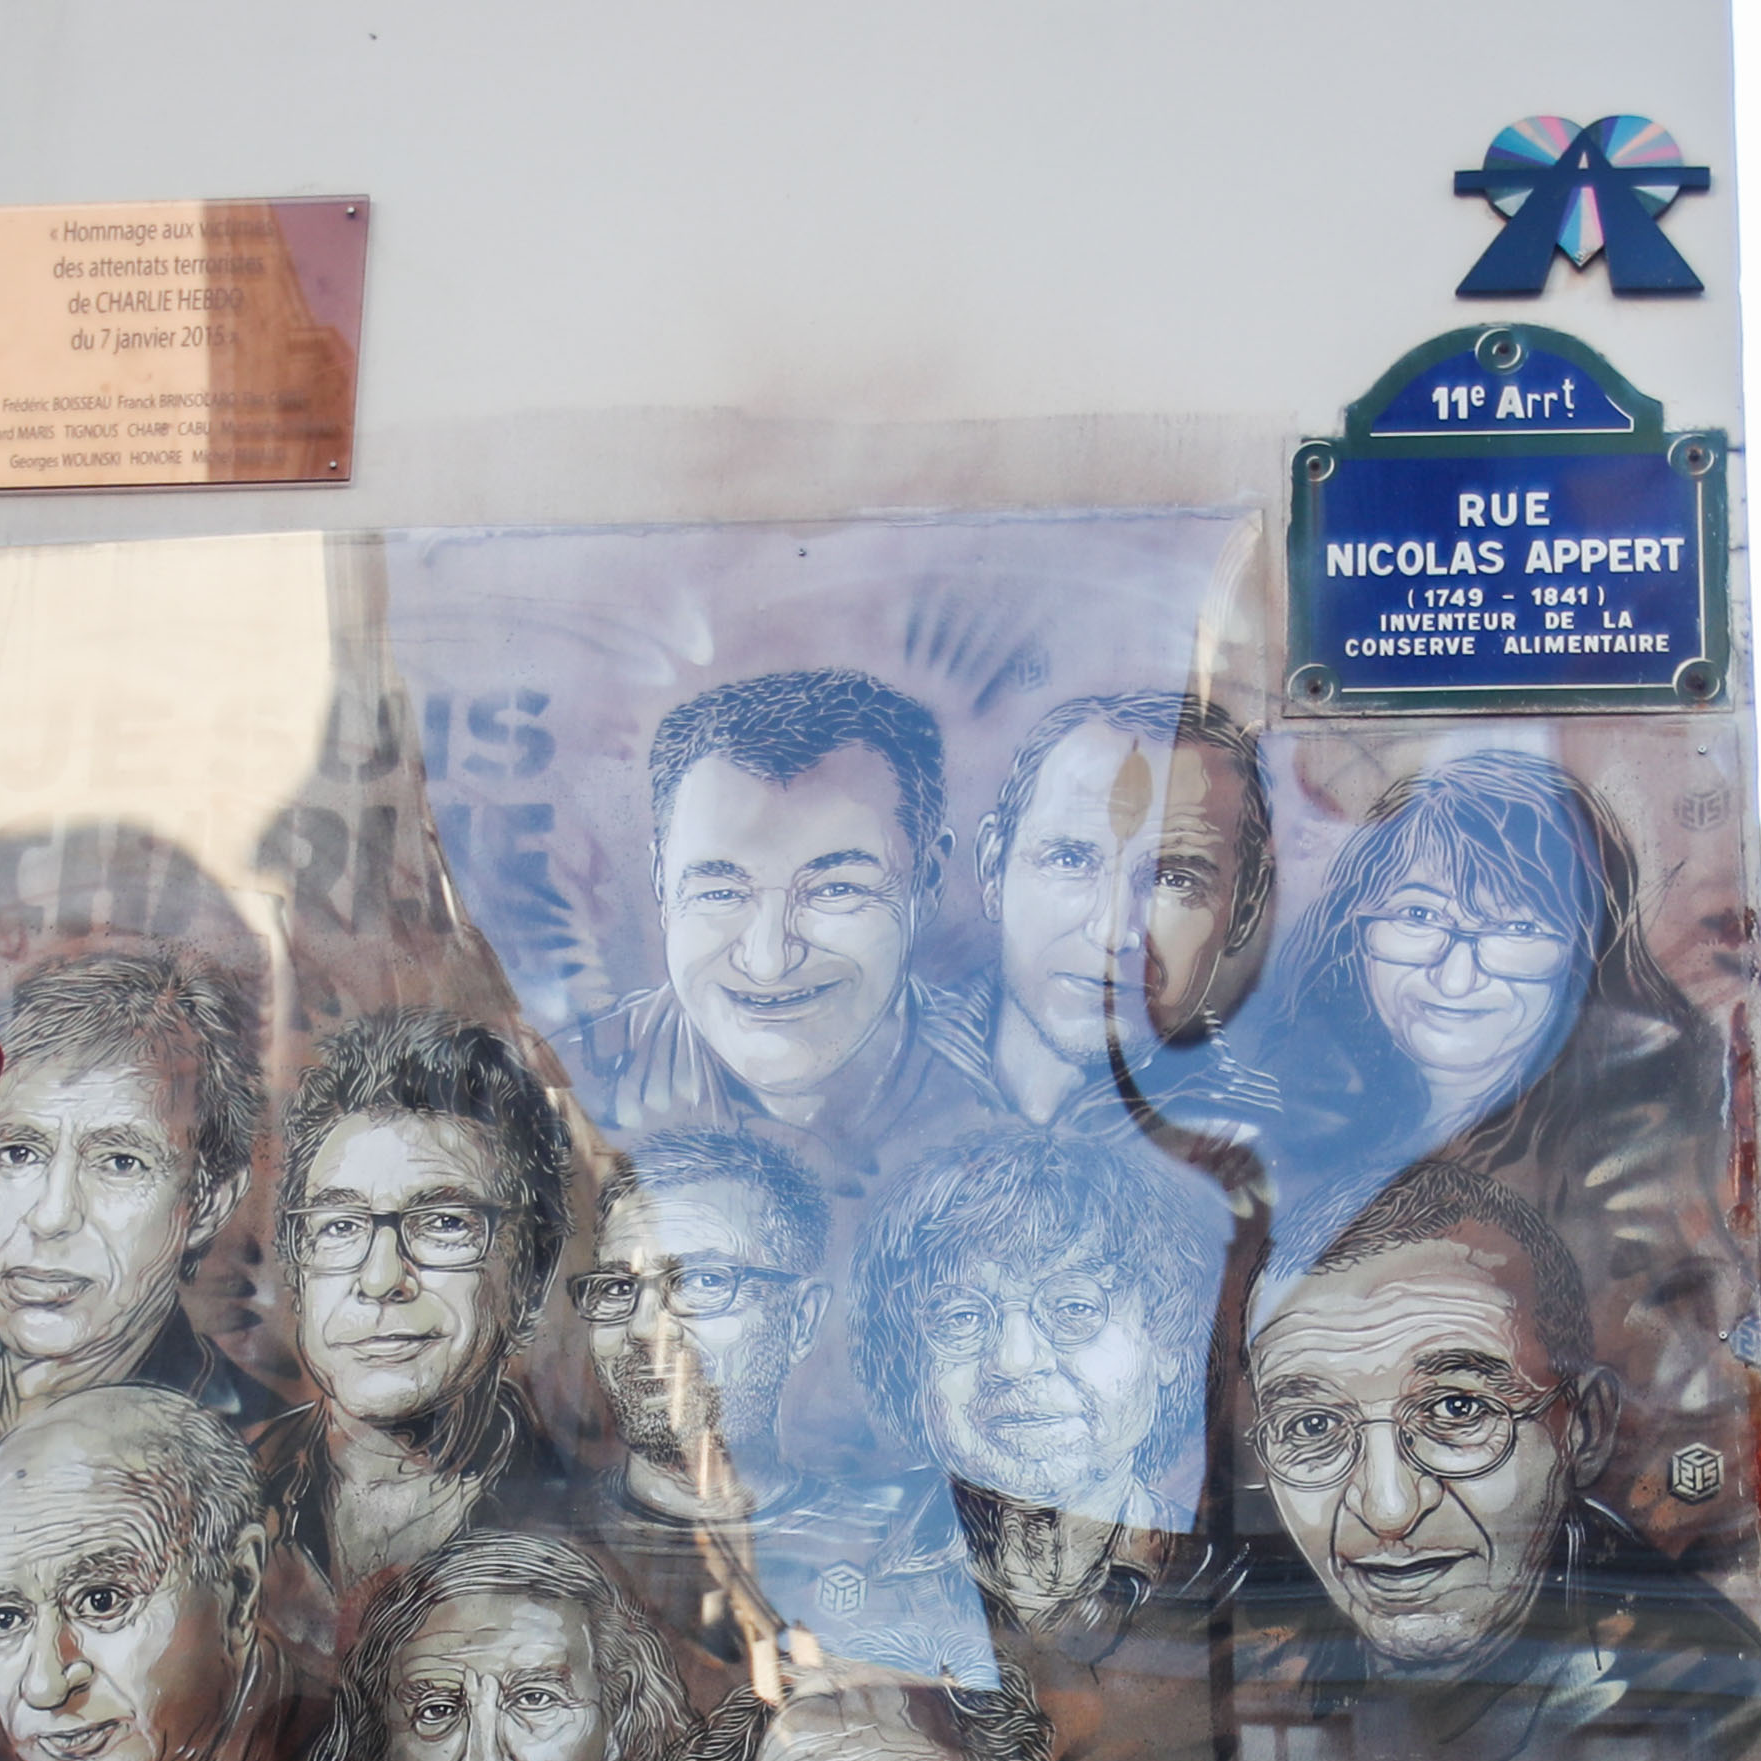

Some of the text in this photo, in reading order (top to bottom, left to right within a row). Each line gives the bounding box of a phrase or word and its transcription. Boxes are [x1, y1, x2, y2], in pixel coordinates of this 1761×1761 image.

[63, 220, 158, 246] Hommage
[162, 222, 194, 238] aux
[53, 253, 265, 279] des attentats terroristes
[68, 287, 244, 314] de CHARLIE HEBDO
[70, 328, 94, 350] du
[100, 328, 110, 348] 7
[113, 327, 176, 354] janvier
[181, 325, 225, 348] 2015
[53, 396, 112, 411] BOISSEAU
[117, 394, 157, 410] Franck
[17, 424, 55, 441] MARIS
[64, 423, 119, 440] TIGNOUS
[178, 420, 210, 437] CABU
[10, 453, 59, 471] Georges
[62, 451, 121, 469] WOLINSKI
[1458, 492, 1551, 528] RUE
[1326, 537, 1685, 578] NICOLAS APPERT
[1380, 609, 1633, 632] INVENTEUR DE LA
[1345, 633, 1671, 658] CONSERVE ALIMENTAIRE
